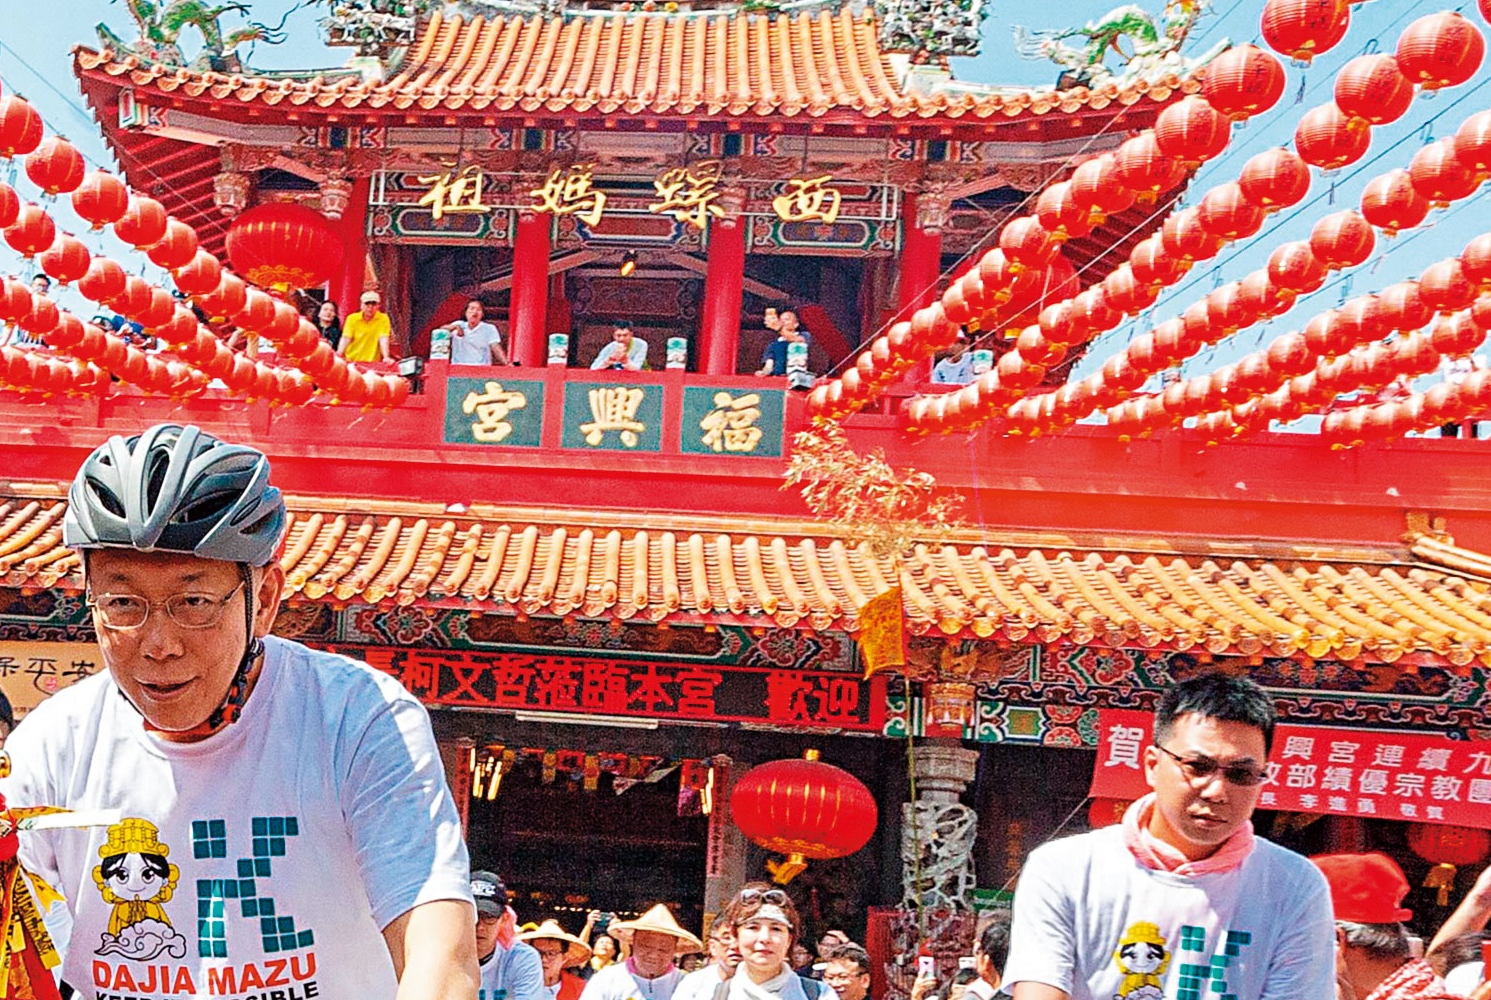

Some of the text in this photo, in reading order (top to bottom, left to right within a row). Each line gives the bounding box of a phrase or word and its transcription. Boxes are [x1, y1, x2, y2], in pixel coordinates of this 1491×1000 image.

[765, 672, 859, 723] 歡迎
[1104, 724, 1144, 770] 賀
[92, 952, 317, 995] DAJIA MAZU
